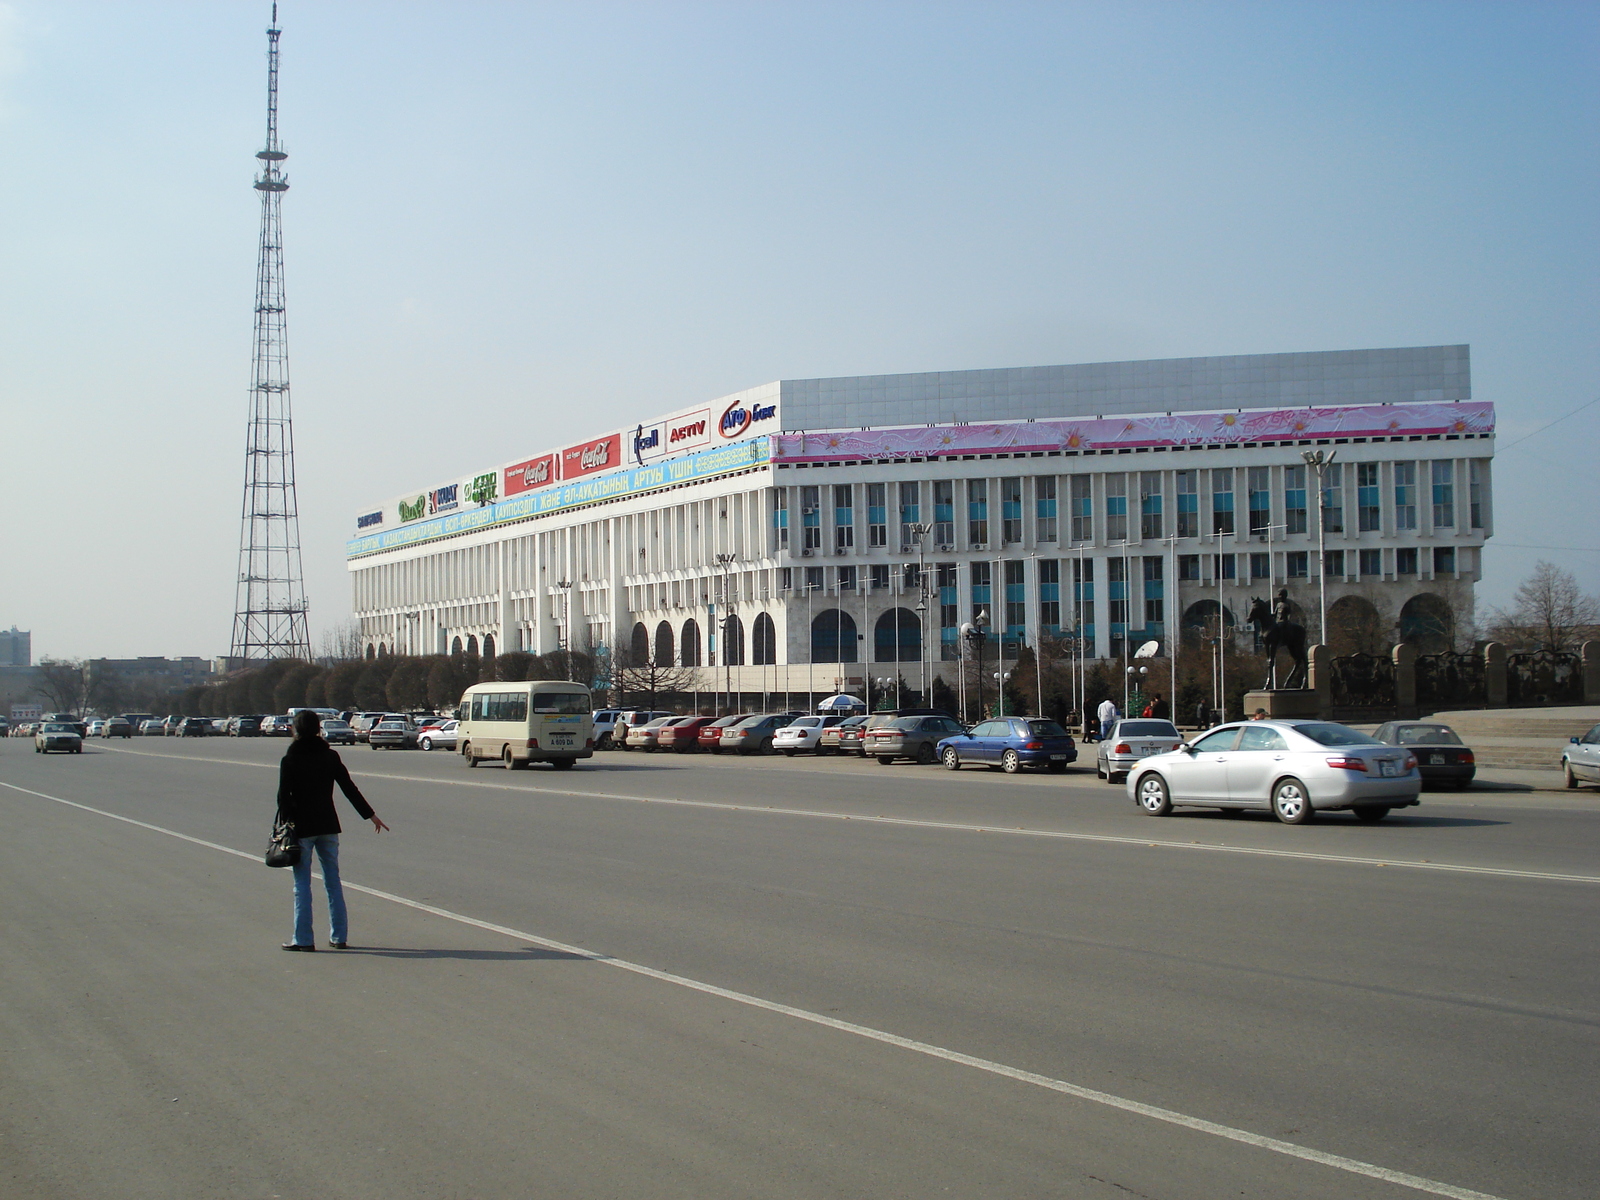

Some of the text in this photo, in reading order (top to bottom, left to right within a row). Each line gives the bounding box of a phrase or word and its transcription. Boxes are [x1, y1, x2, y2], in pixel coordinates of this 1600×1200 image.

[723, 408, 746, 430] АТФ
[540, 491, 561, 510] ЖӘНЕ
[564, 474, 630, 504] ӘЛ-АУҚАТЫНЫҢ
[633, 466, 664, 488] АРТУЫ
[668, 458, 693, 480] ҮШІН
